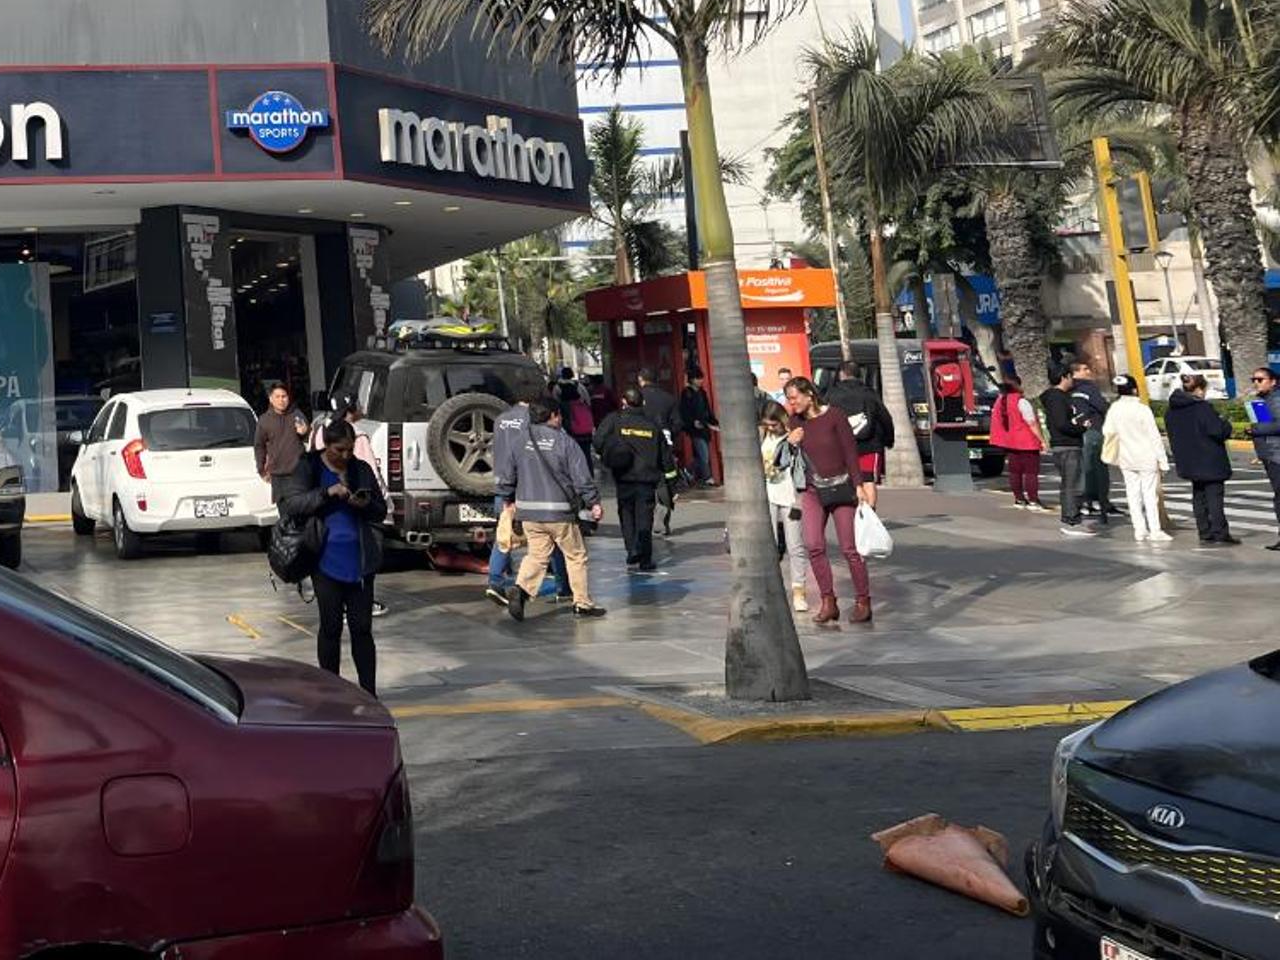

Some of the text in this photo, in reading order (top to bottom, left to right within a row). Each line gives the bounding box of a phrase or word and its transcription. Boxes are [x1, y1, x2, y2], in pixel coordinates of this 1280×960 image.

[232, 108, 322, 124] marathon
[259, 128, 300, 138] SPORTS
[378, 107, 574, 190] marathon
[1152, 807, 1176, 826] KIA
